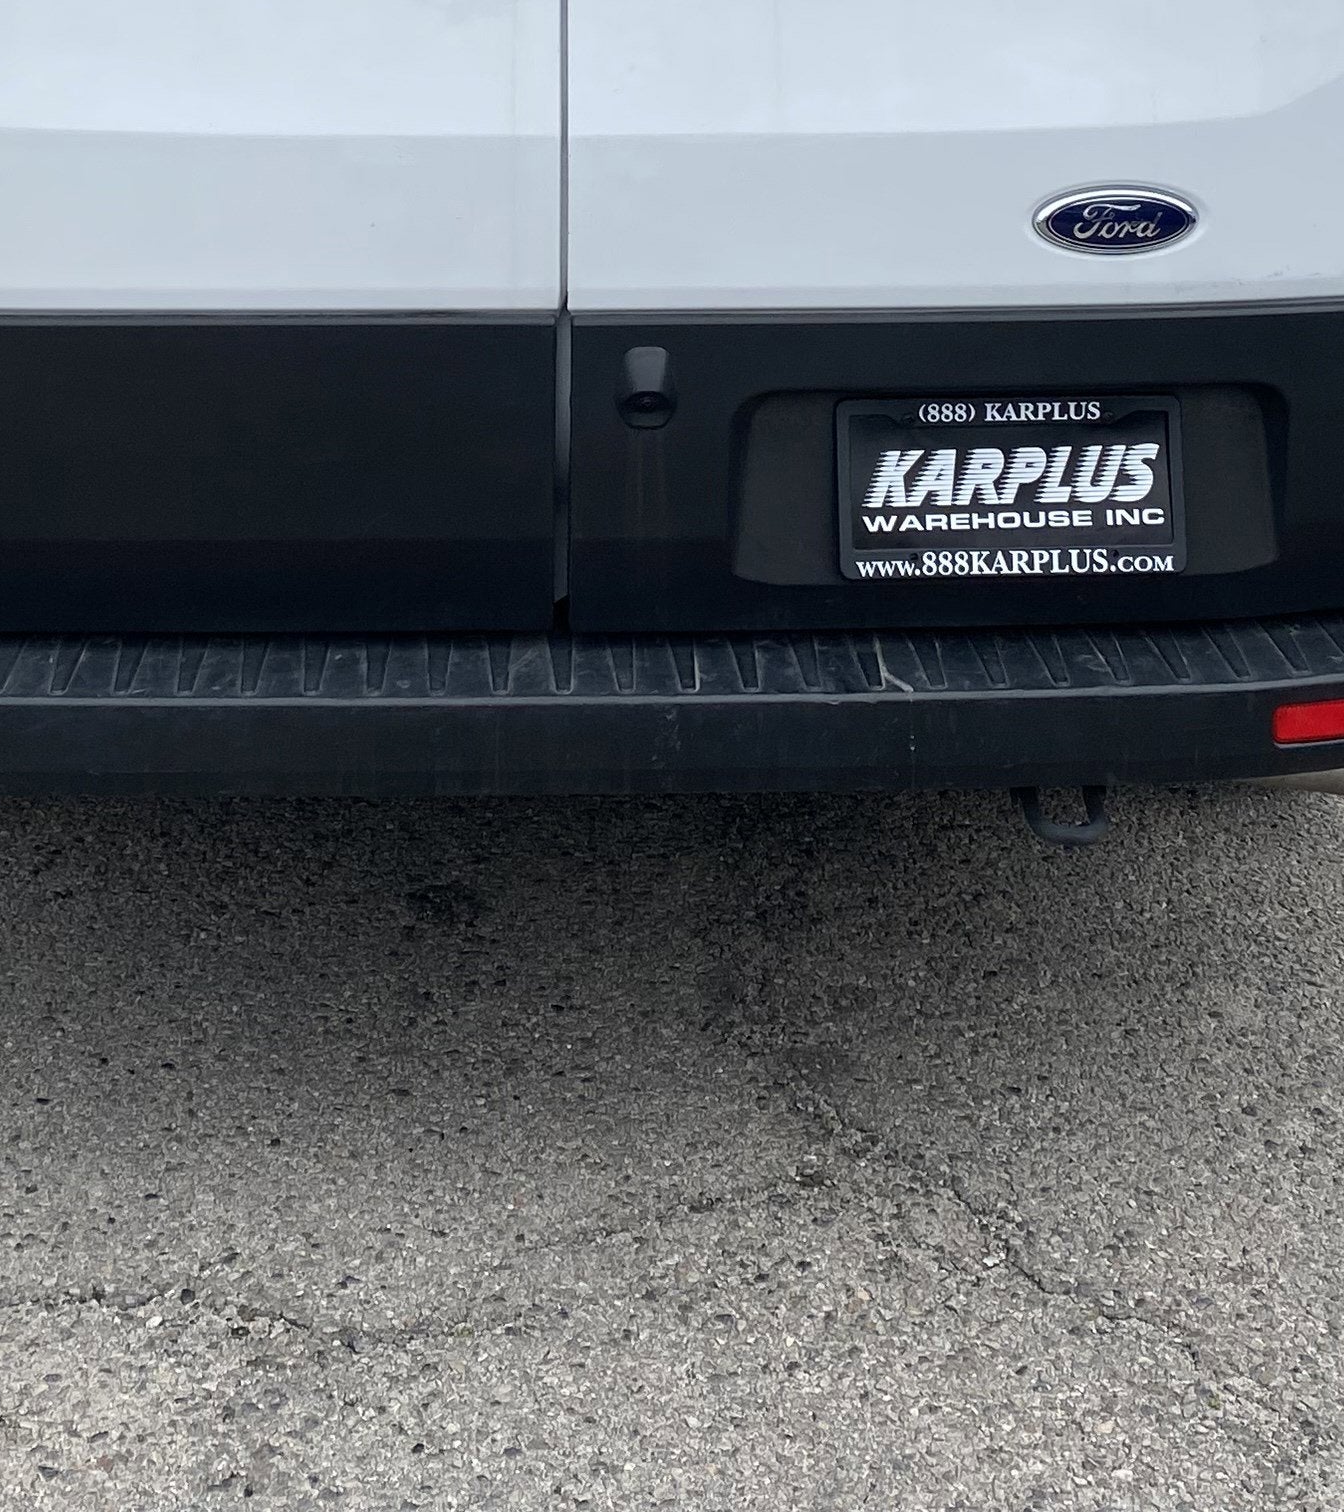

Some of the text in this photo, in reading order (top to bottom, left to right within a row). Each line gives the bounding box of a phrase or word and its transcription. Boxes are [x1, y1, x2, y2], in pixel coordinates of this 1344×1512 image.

[1073, 203, 1162, 239] Ford
[918, 401, 1101, 423] (888) KARPLUS
[861, 442, 1160, 508] KARPLUS
[862, 507, 1165, 532] WAREHOUSE INC
